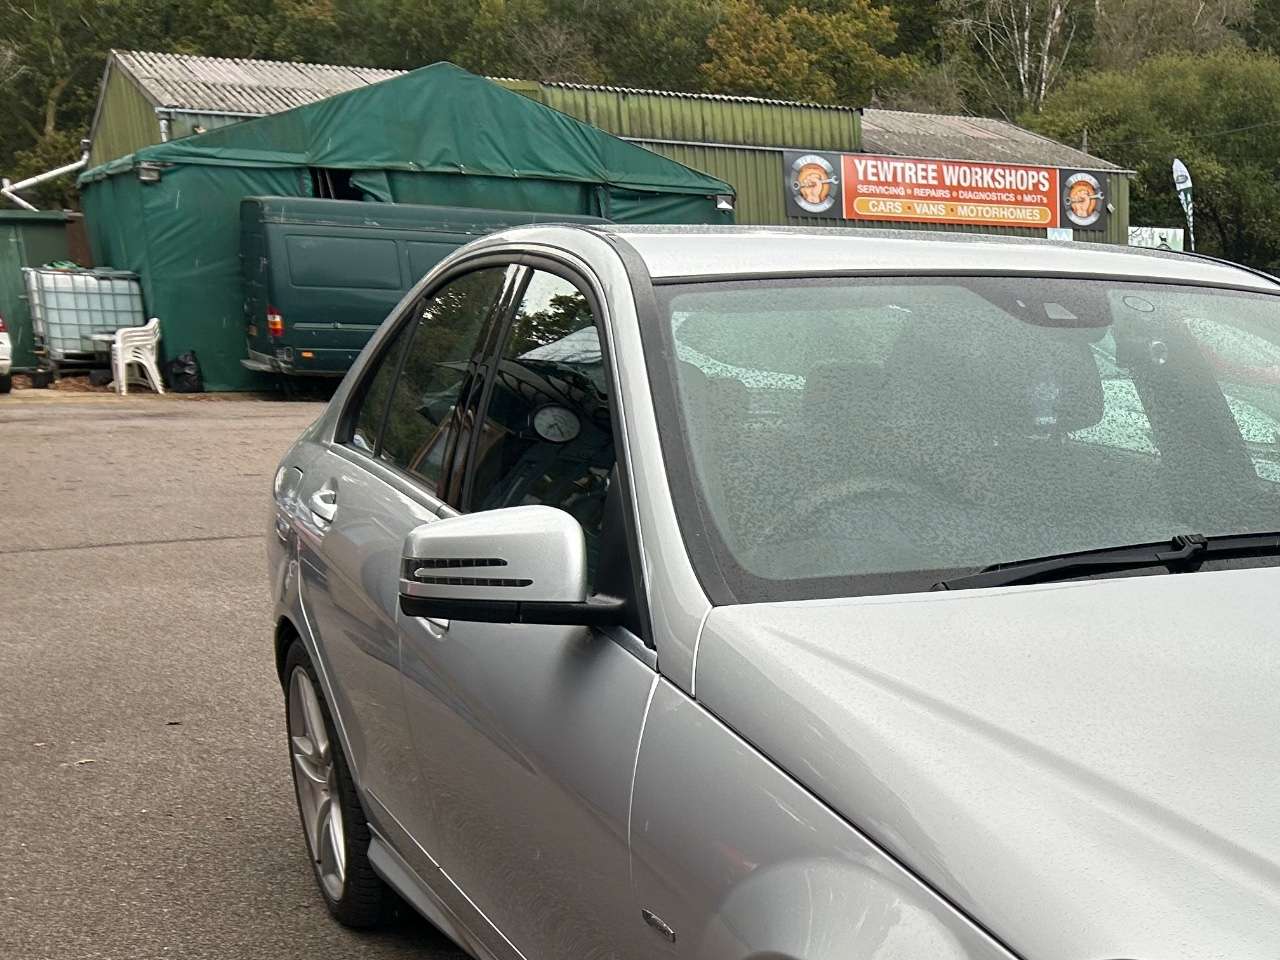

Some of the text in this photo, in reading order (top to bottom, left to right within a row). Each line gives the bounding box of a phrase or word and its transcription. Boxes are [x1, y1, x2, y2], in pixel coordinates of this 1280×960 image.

[853, 159, 938, 185] YEWTREE
[942, 164, 1050, 192] WORKSHOPS
[857, 184, 906, 196] SERVICING
[913, 187, 951, 198] REPAIRS
[958, 190, 1016, 202] DIAGNOSTICS
[868, 200, 1041, 221] CARS VANS MOTORHOMES
